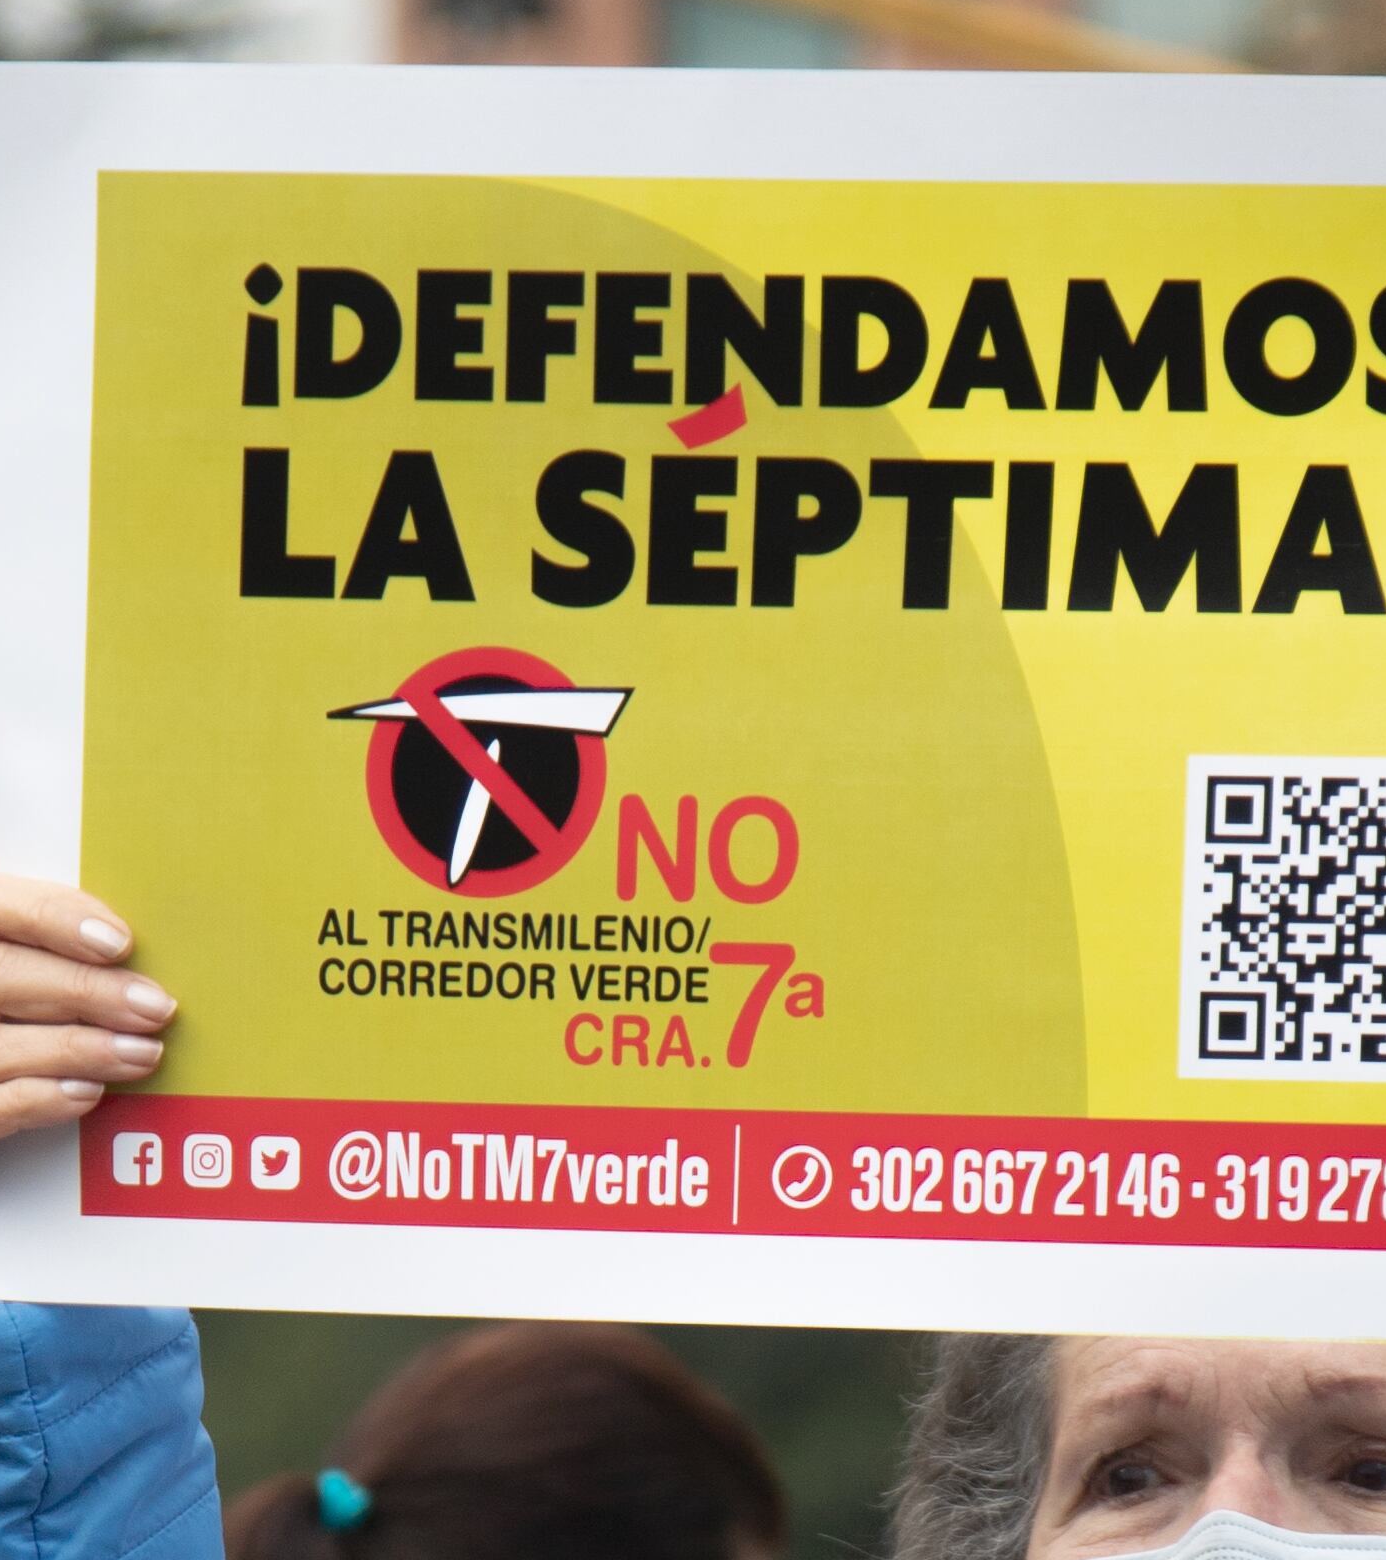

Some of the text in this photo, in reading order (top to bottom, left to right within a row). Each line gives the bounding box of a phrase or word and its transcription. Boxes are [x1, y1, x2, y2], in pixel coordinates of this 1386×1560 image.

[239, 447, 477, 602] LA
[615, 793, 800, 904] NO
[317, 908, 712, 954] AL TRANSMILENIO/
[318, 957, 710, 1003] CORREDOR VERDE
[564, 1011, 712, 1068] CRA.
[328, 1129, 710, 1207] @NoTM7verde
